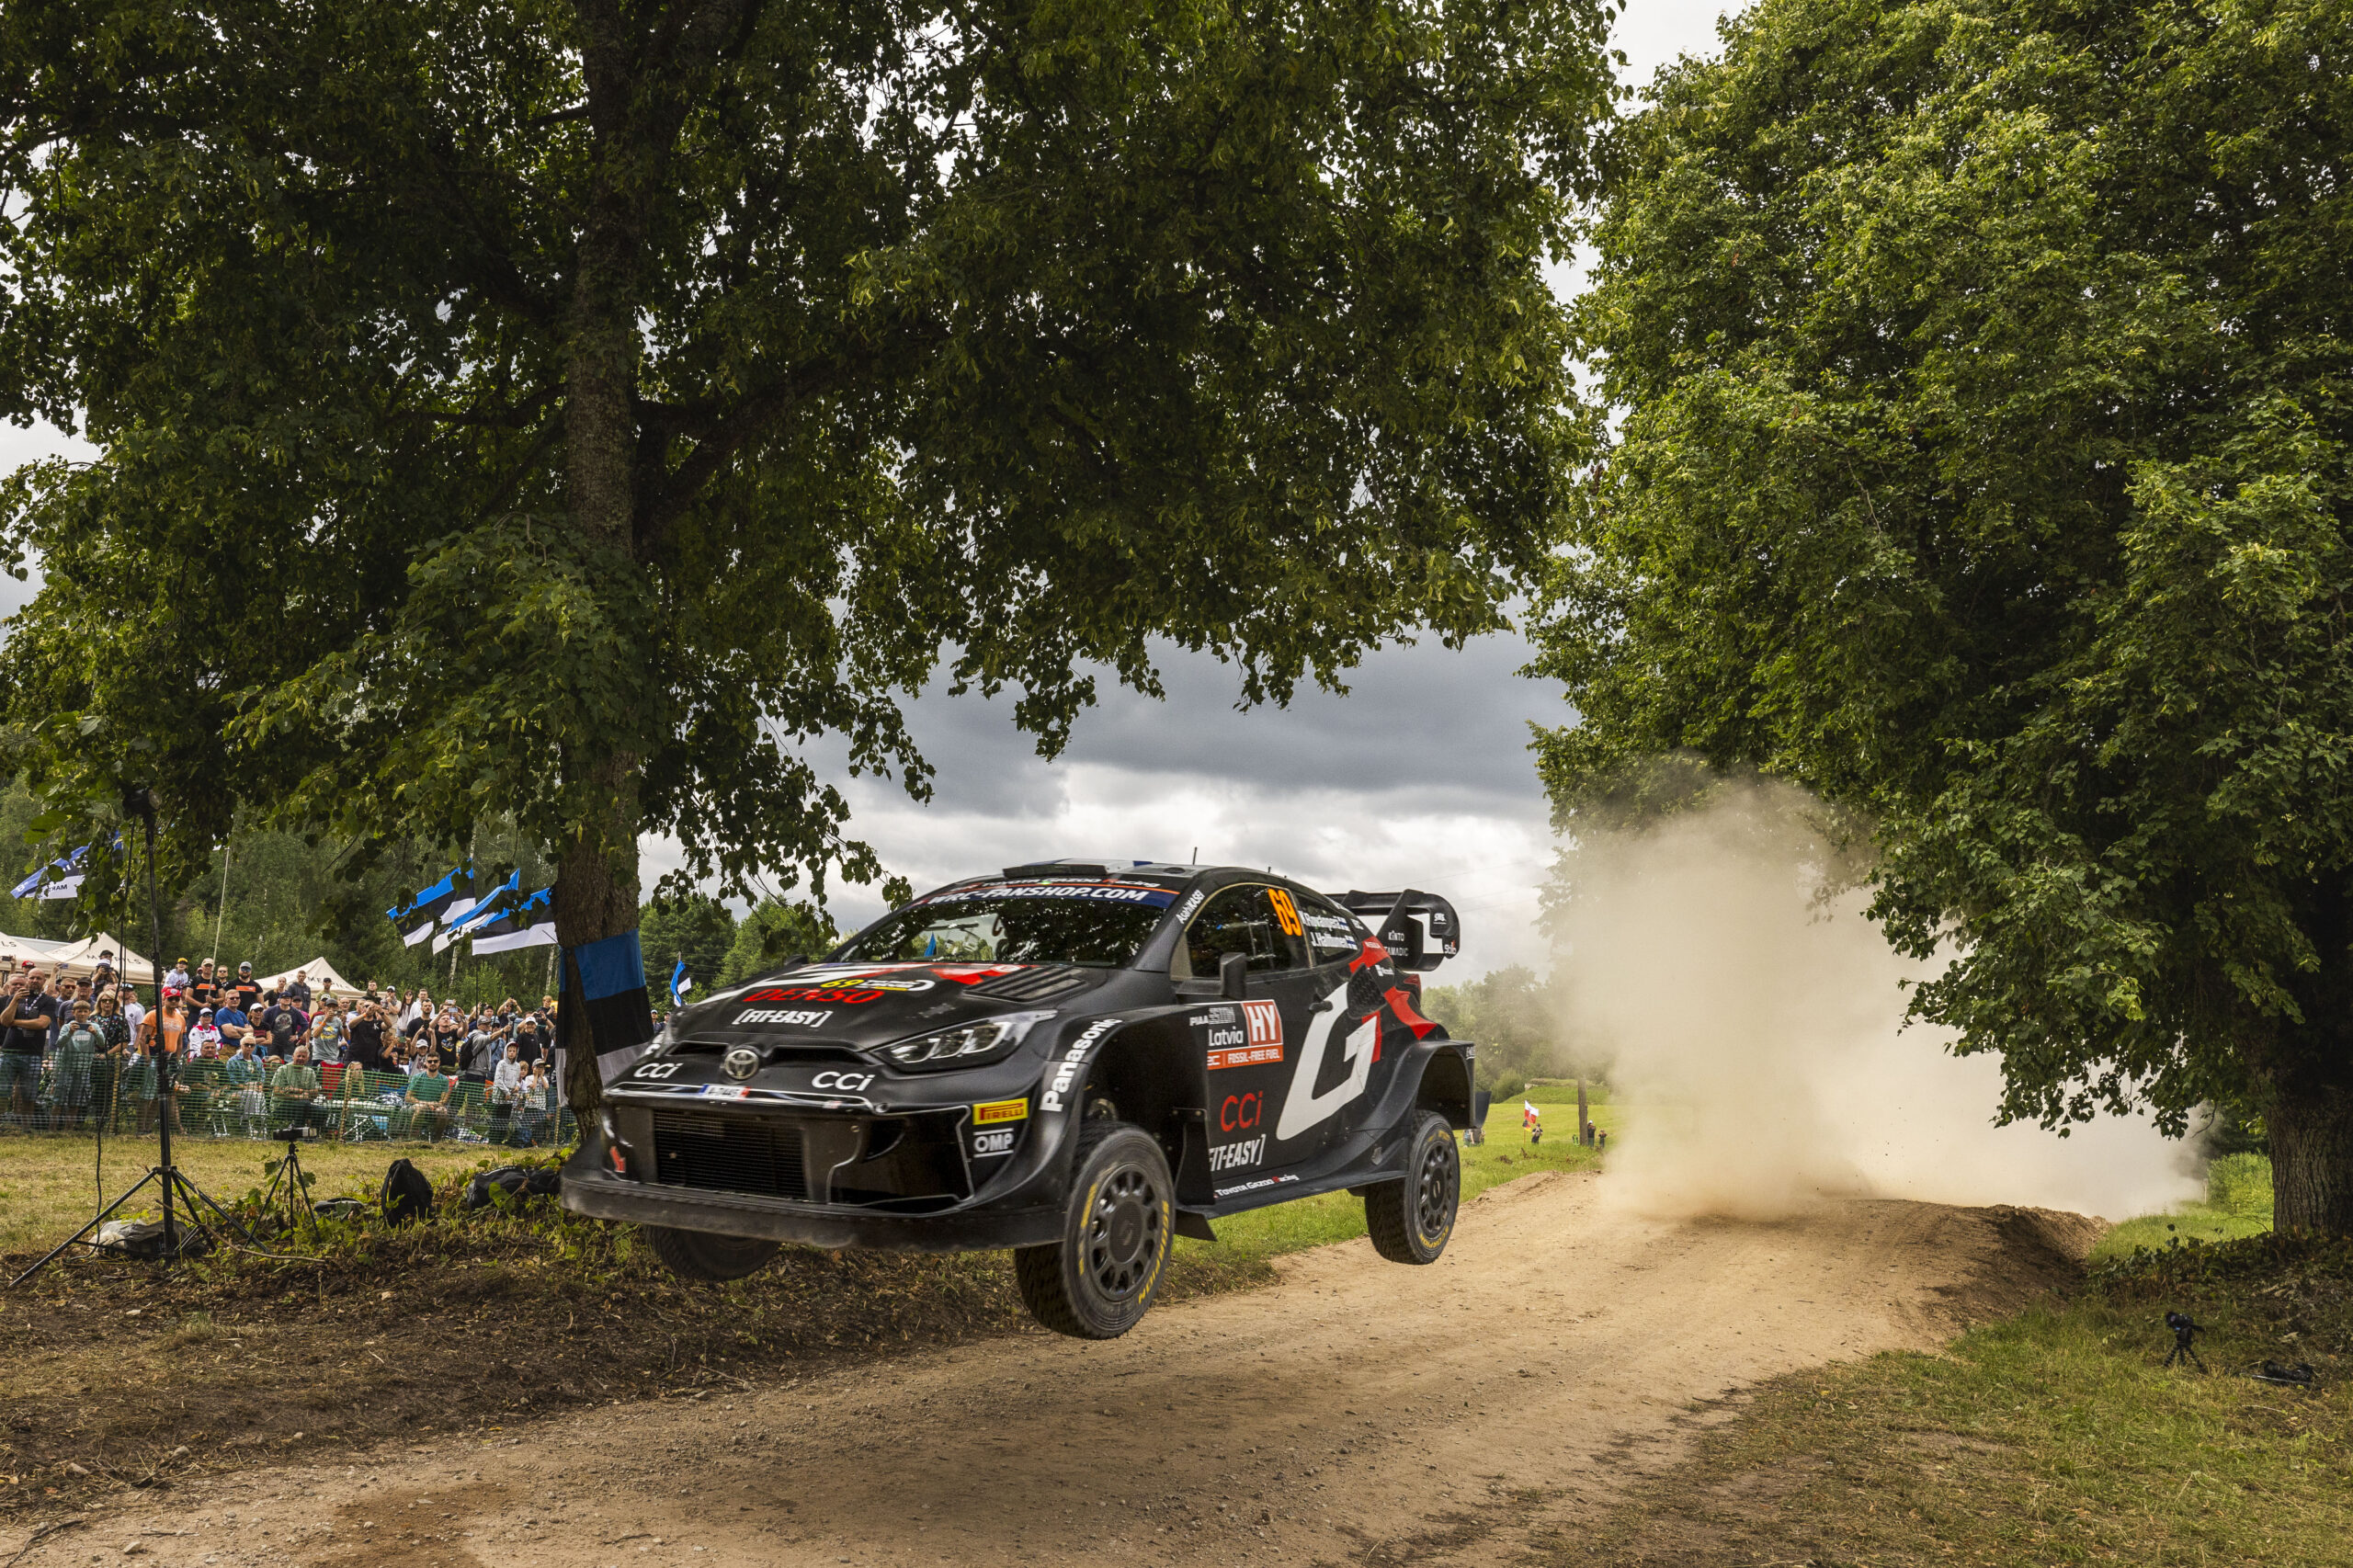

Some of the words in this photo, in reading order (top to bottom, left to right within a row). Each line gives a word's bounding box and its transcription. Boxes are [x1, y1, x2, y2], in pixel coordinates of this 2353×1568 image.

[1102, 878, 1161, 889] Racing
[927, 886, 1150, 904] WRC-FANSHOP.COM
[1267, 888, 1302, 937] 69
[820, 979, 865, 988] 69
[743, 988, 885, 1004] DENSO
[1246, 1005, 1277, 1042] HY
[1208, 1025, 1244, 1046] Latvia
[1040, 1018, 1123, 1112] Panasonic
[1227, 1051, 1266, 1064] FOSSIL-FREE
[1266, 1049, 1280, 1060] FUEL
[811, 1071, 876, 1092] CCi
[979, 1102, 1025, 1121] PIRELLI
[1221, 1090, 1264, 1132] CCi
[974, 1132, 1014, 1153] OMP
